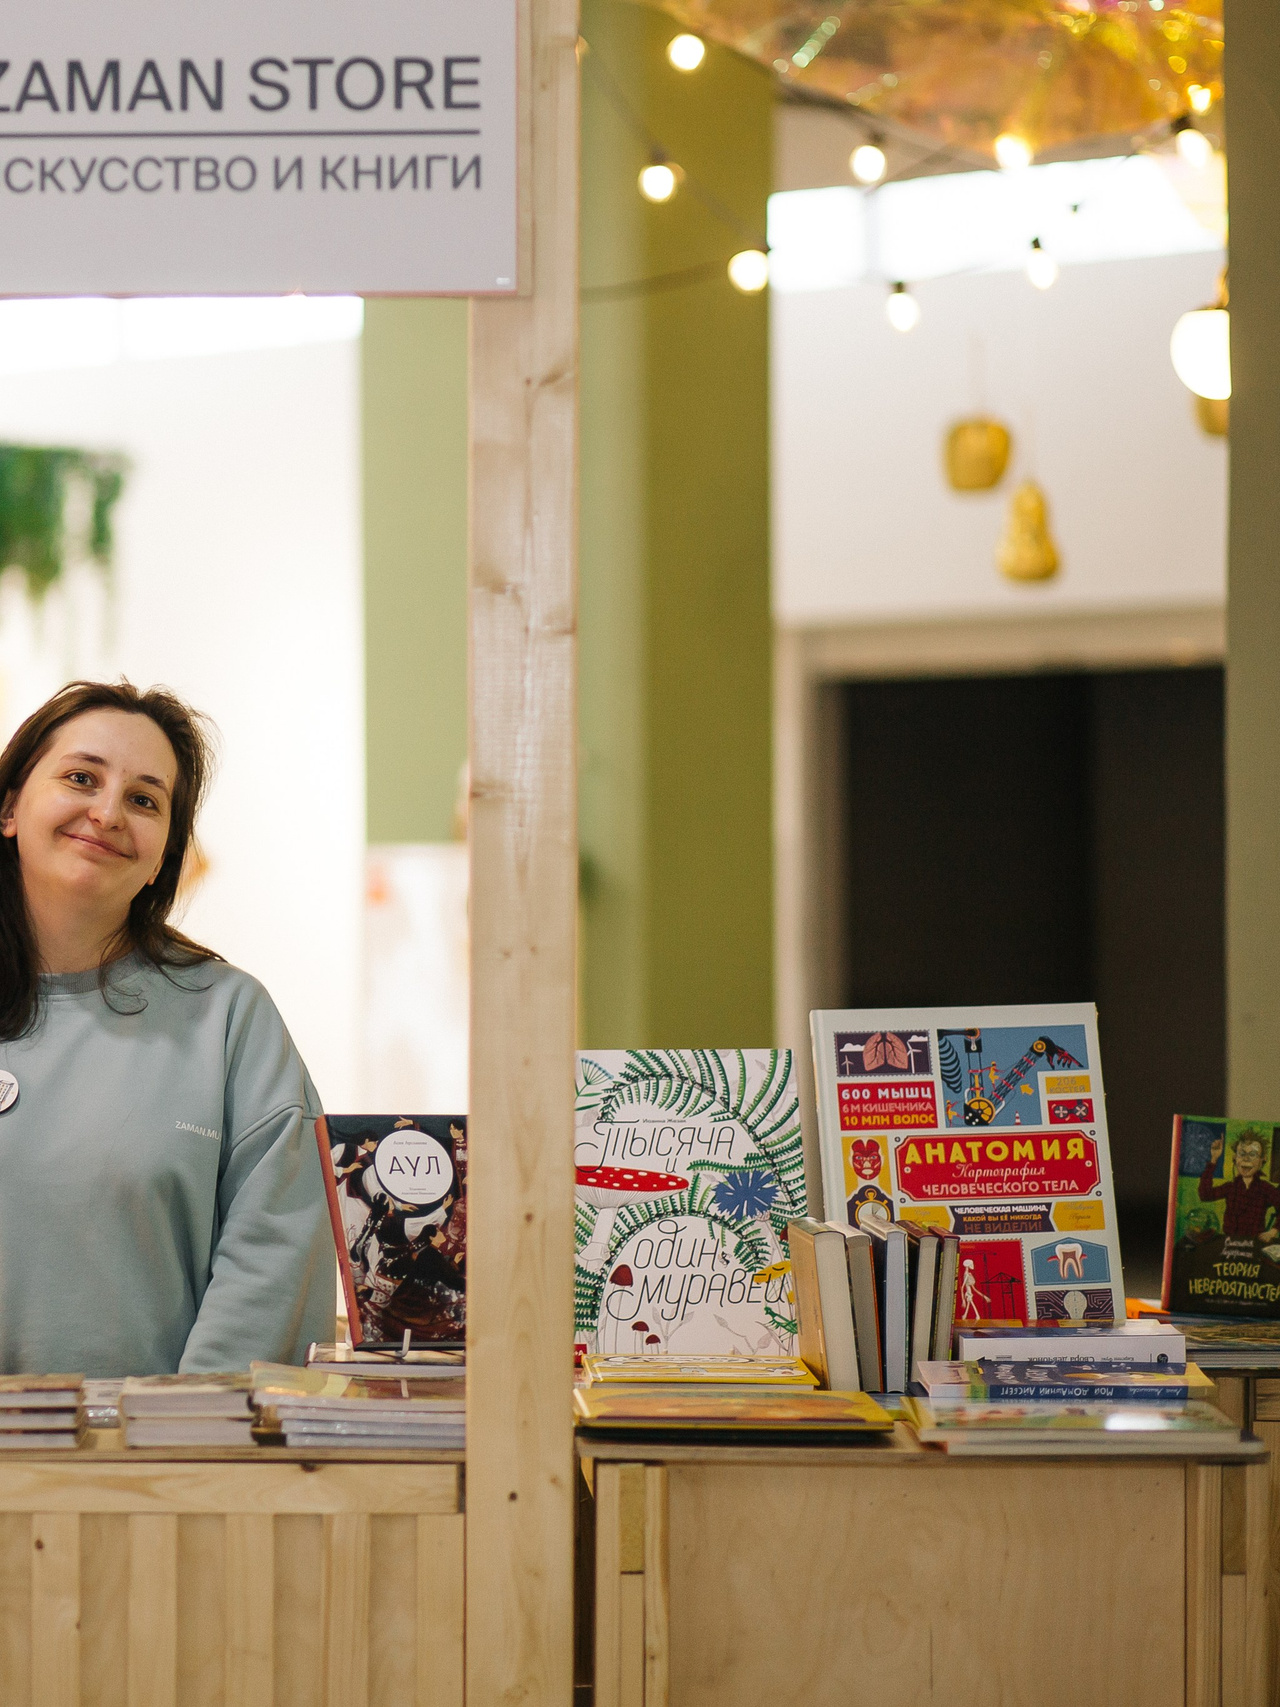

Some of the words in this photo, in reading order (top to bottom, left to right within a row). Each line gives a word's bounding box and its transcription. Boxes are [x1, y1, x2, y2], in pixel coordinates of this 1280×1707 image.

[247, 55, 482, 112] STORE
[273, 155, 304, 191] И
[319, 154, 482, 191] КНИГИ
[841, 1088, 871, 1100] 600
[877, 1087, 933, 1100] МЫШЦ
[842, 1103, 850, 1113] 6
[850, 1103, 861, 1113] М
[862, 1102, 934, 1113] КИШЕЧНИКА
[843, 1115, 859, 1126] 10
[861, 1115, 890, 1126] МЛН
[893, 1114, 935, 1125] ВОЛОС
[905, 1138, 1085, 1164] АНАТОМИЯ
[389, 1155, 441, 1177] АУЛ
[952, 1162, 1046, 1182] Картография
[922, 1181, 1040, 1196] ЧЕЛОВЕЧЕСКОГО
[1042, 1179, 1080, 1192] ТЕЛА
[954, 1206, 1011, 1215] ЧЕЛОВЕЧЕСКАЯ
[962, 1214, 986, 1222] КАКОЙ
[964, 1223, 982, 1234] НЕ
[984, 1222, 1043, 1233] ВИДЕЛИ!
[1213, 1262, 1261, 1278] ТЕОРИЯ
